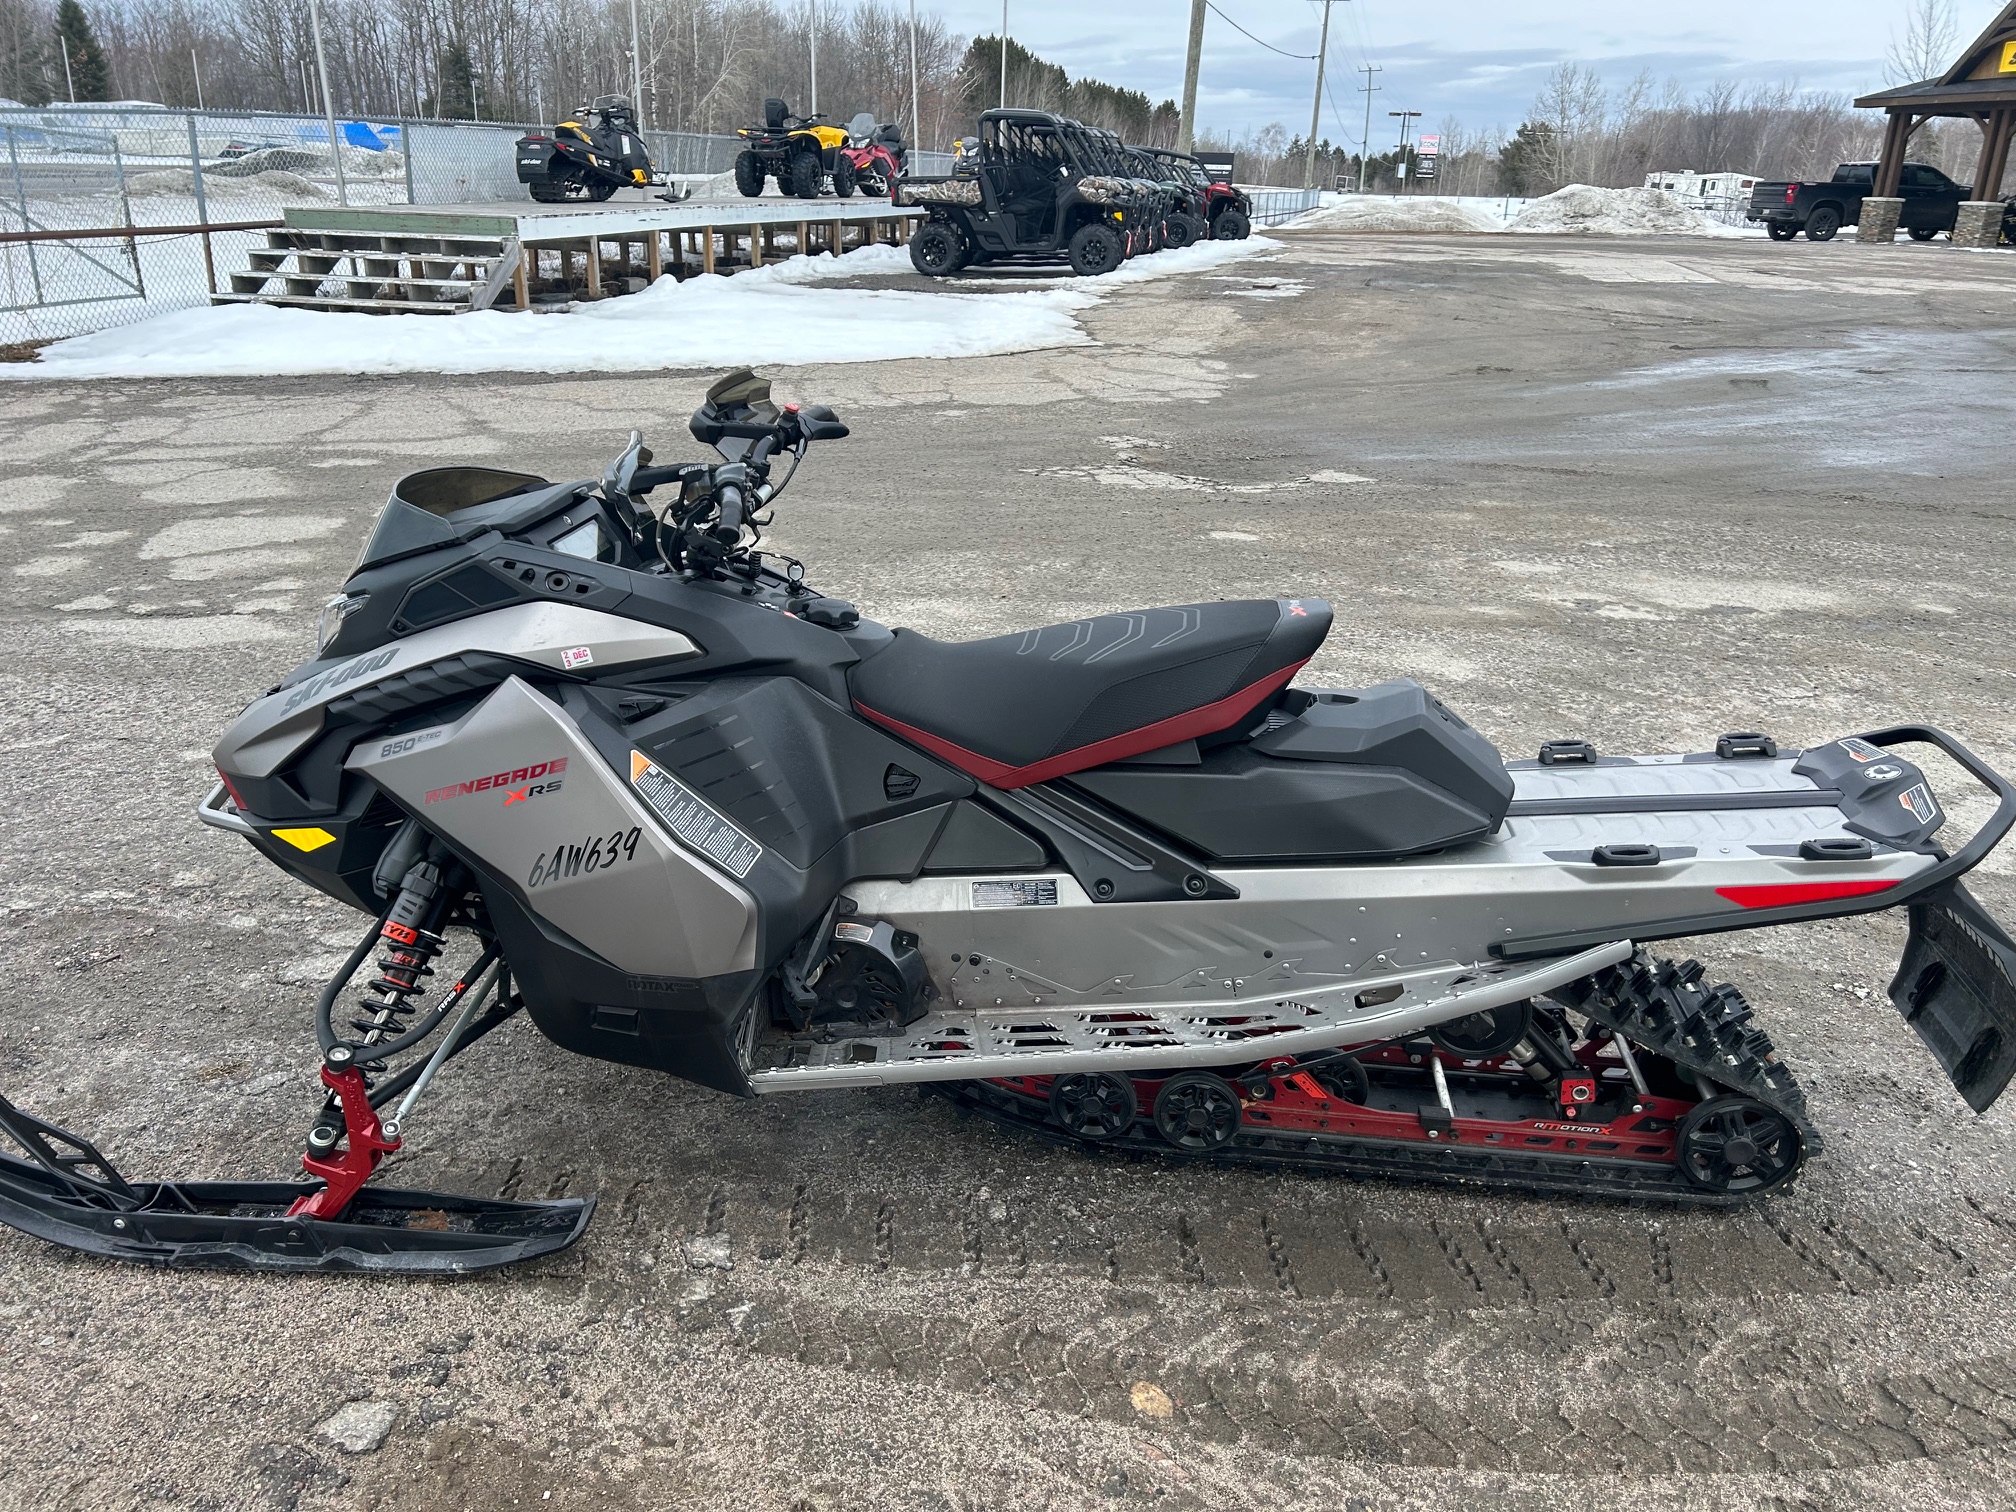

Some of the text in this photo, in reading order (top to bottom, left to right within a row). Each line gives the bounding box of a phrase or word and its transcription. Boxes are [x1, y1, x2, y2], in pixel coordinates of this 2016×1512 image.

[573, 649, 589, 660] DEC
[381, 731, 442, 757] 850 E-TEC
[424, 757, 568, 805] RENEGADE
[528, 827, 643, 888] 6AW639
[627, 980, 675, 992] ROTAX
